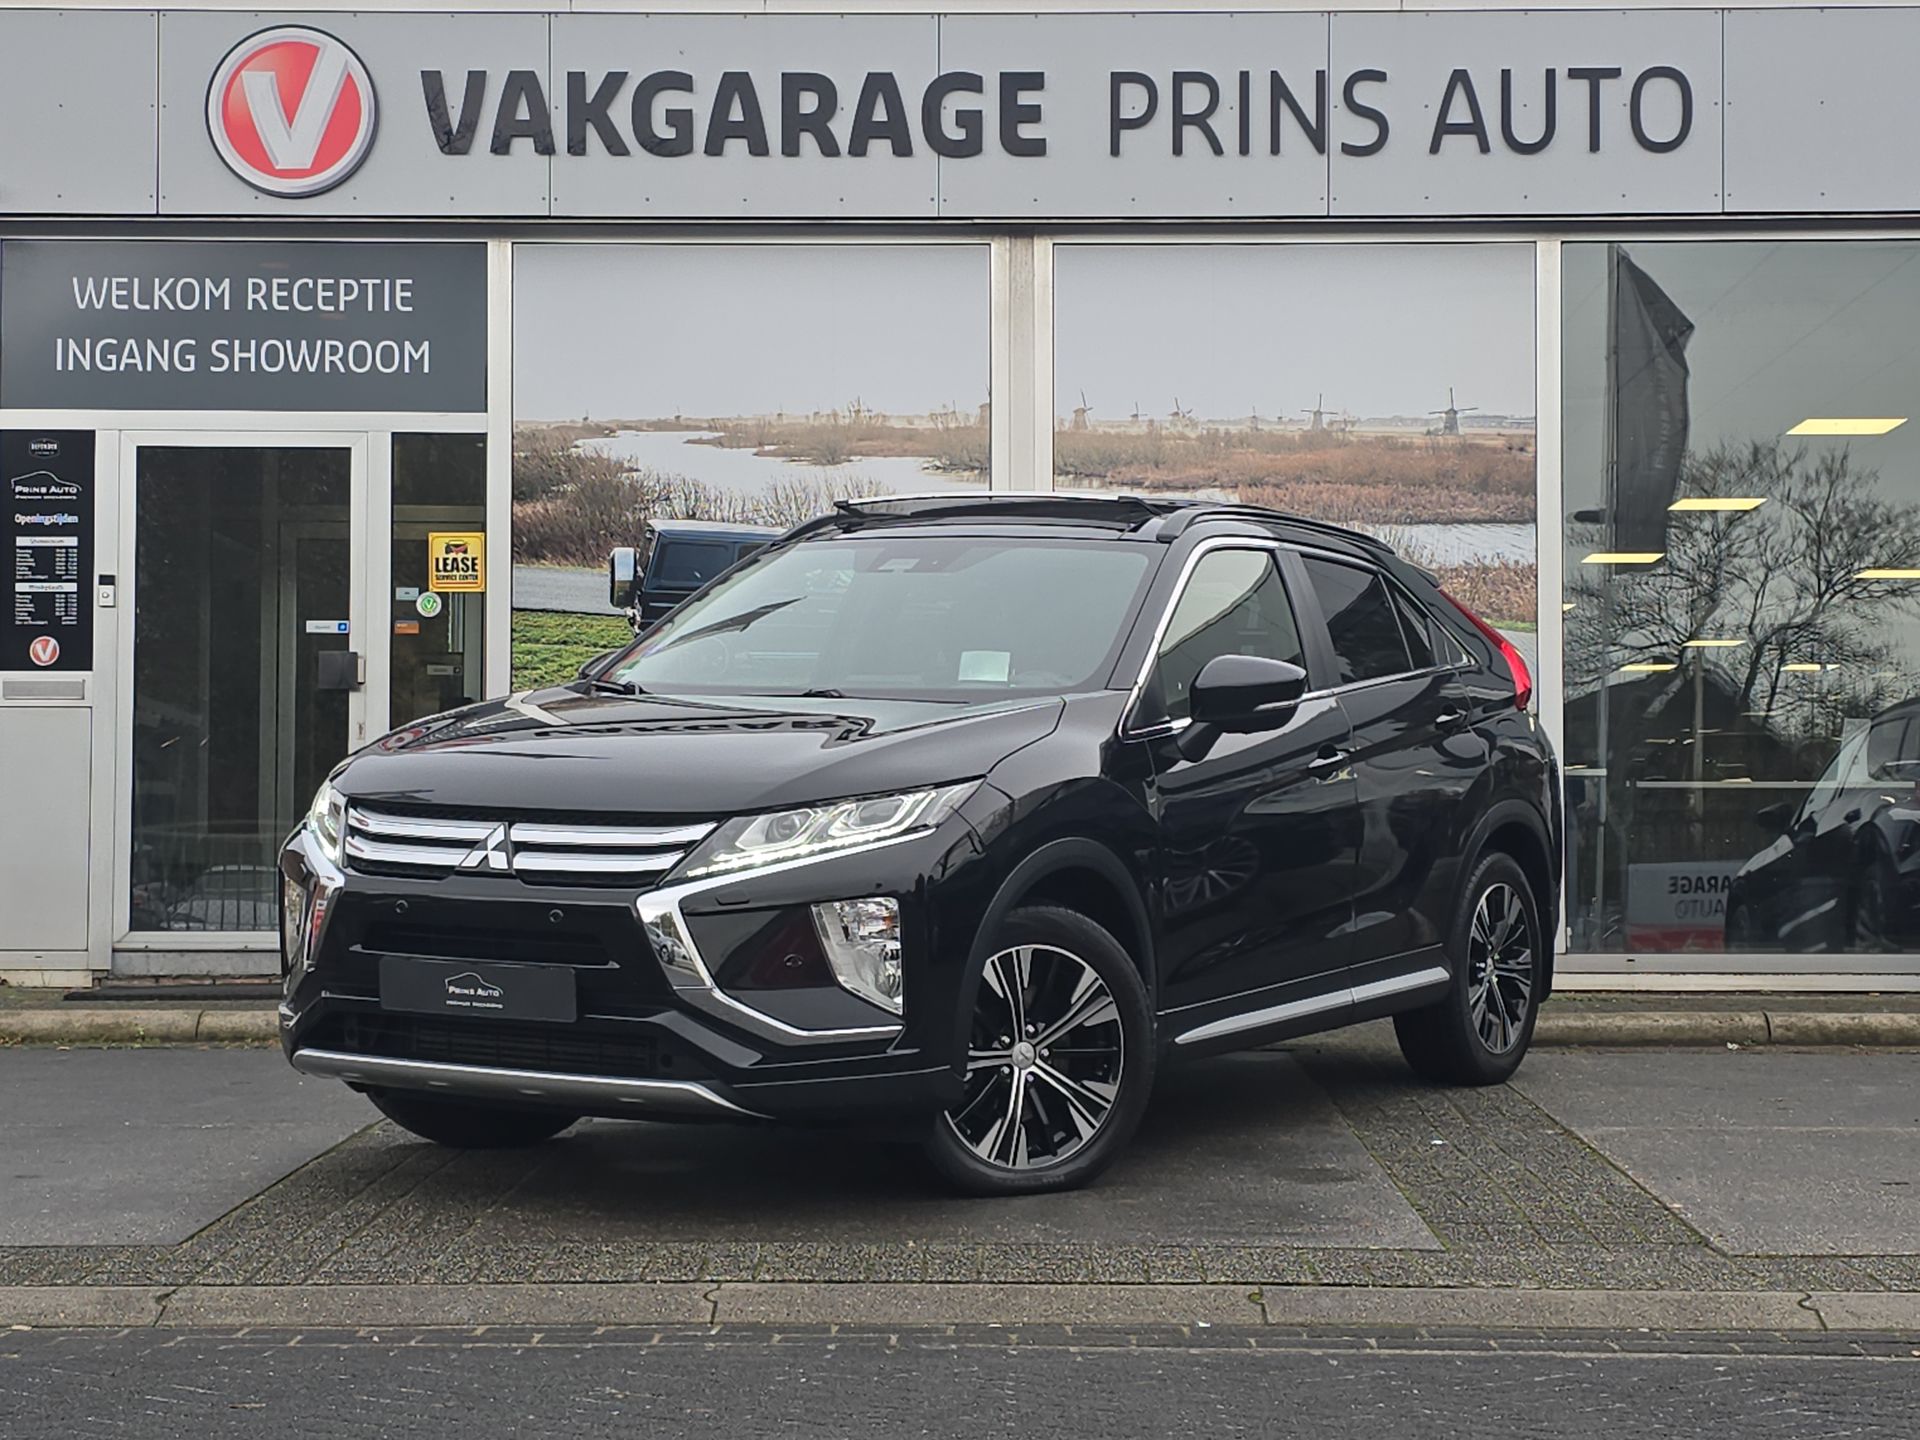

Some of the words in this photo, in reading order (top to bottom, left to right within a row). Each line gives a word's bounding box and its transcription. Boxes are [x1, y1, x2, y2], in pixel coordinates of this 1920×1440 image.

[421, 70, 1048, 158] VAKGARAGE
[1109, 68, 1390, 157] PRINS
[1429, 65, 1693, 155] AUTO
[72, 276, 231, 311] WELKOM
[246, 277, 414, 313] RECEPTIE
[55, 337, 196, 372] INGANG
[209, 338, 431, 374] SHOWROOM
[14, 485, 47, 494] PRINS
[49, 485, 78, 494] AUTO
[435, 556, 478, 573] LEASE
[476, 988, 499, 997] AUTO
